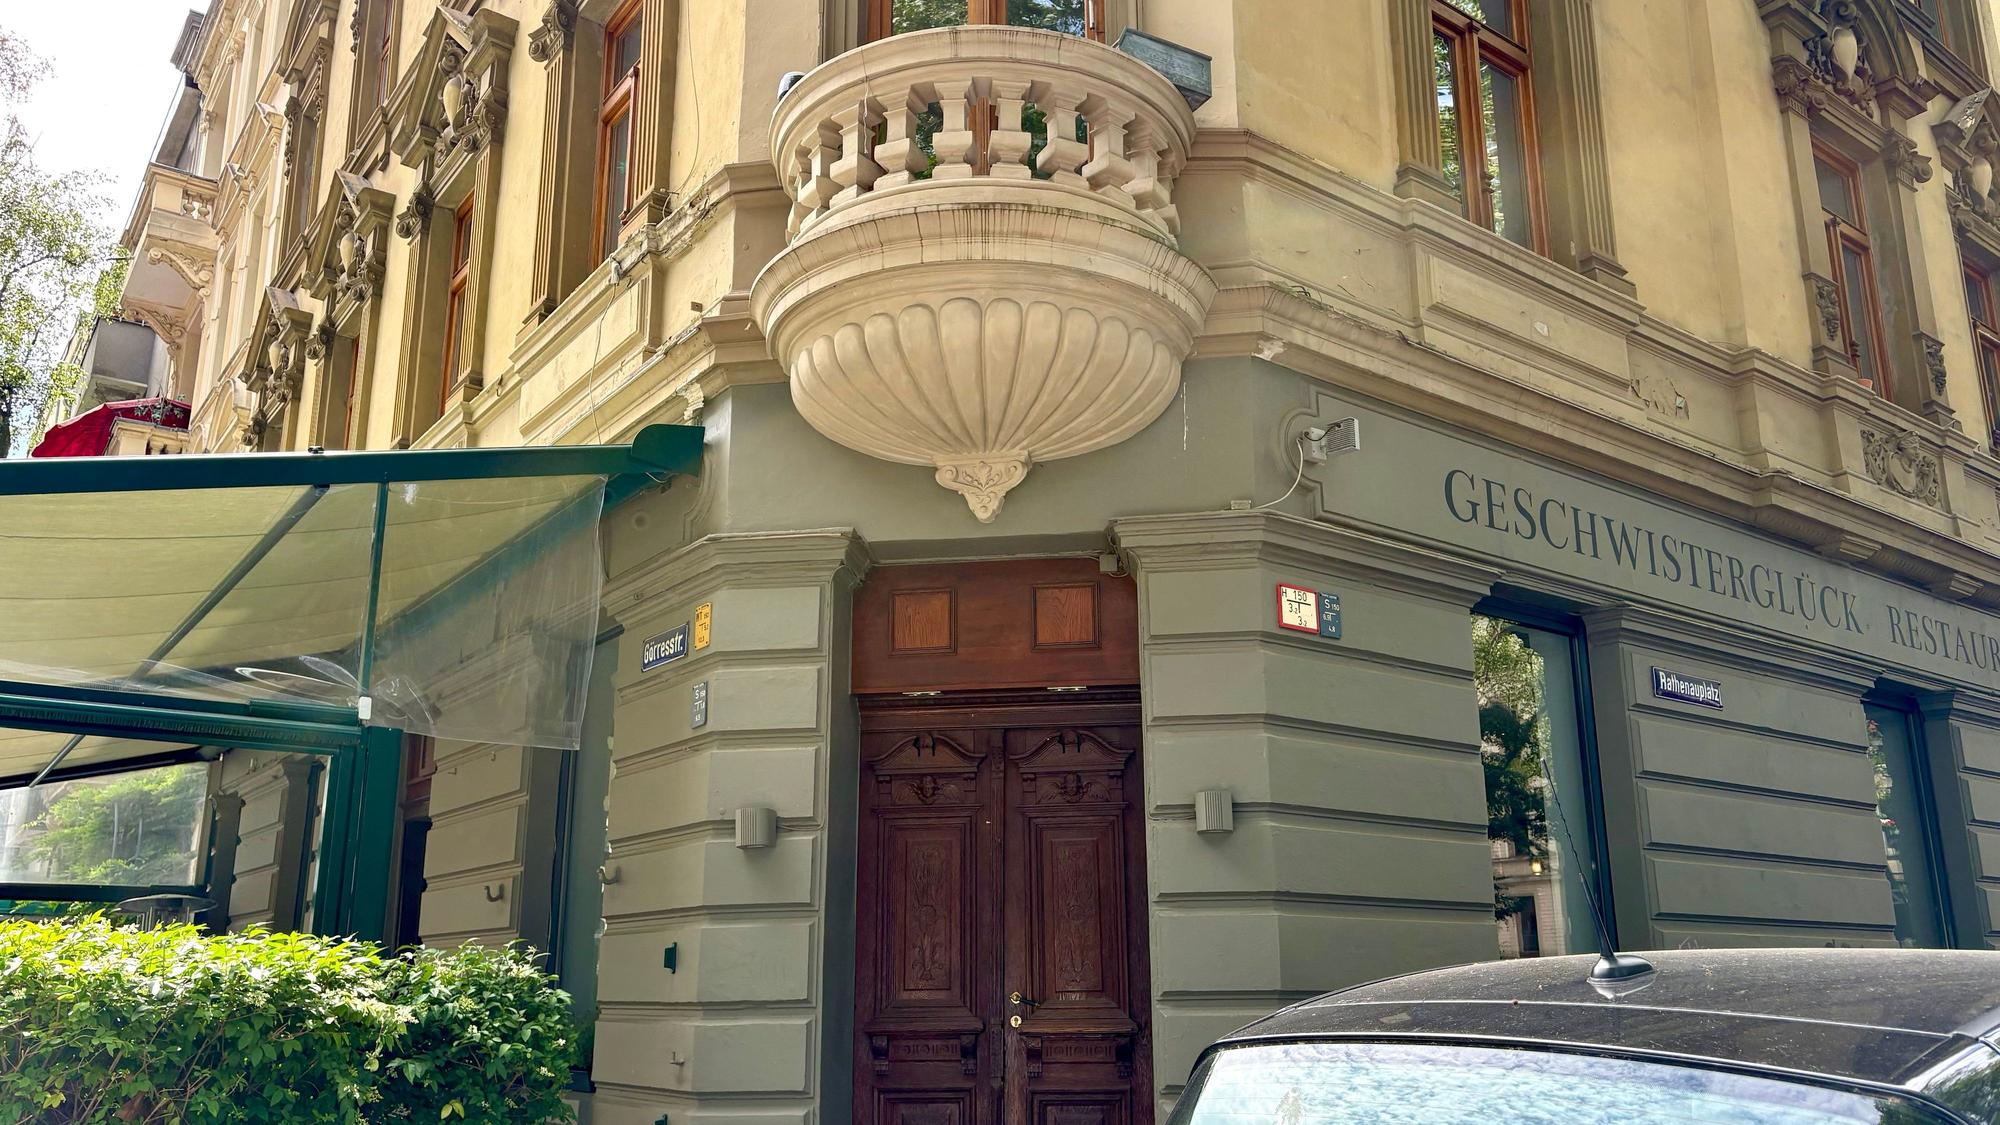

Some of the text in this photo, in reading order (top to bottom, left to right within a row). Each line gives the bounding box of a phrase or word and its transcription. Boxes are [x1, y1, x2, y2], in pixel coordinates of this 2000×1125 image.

[1443, 468, 2000, 673] GESCHWISTERGLÜCK RESTAUR
[1281, 587, 1288, 598] H
[1292, 590, 1308, 602] 150
[1324, 598, 1331, 609] S
[644, 631, 684, 664] Görresstr.
[1658, 670, 1720, 702] Rathenauplatz
